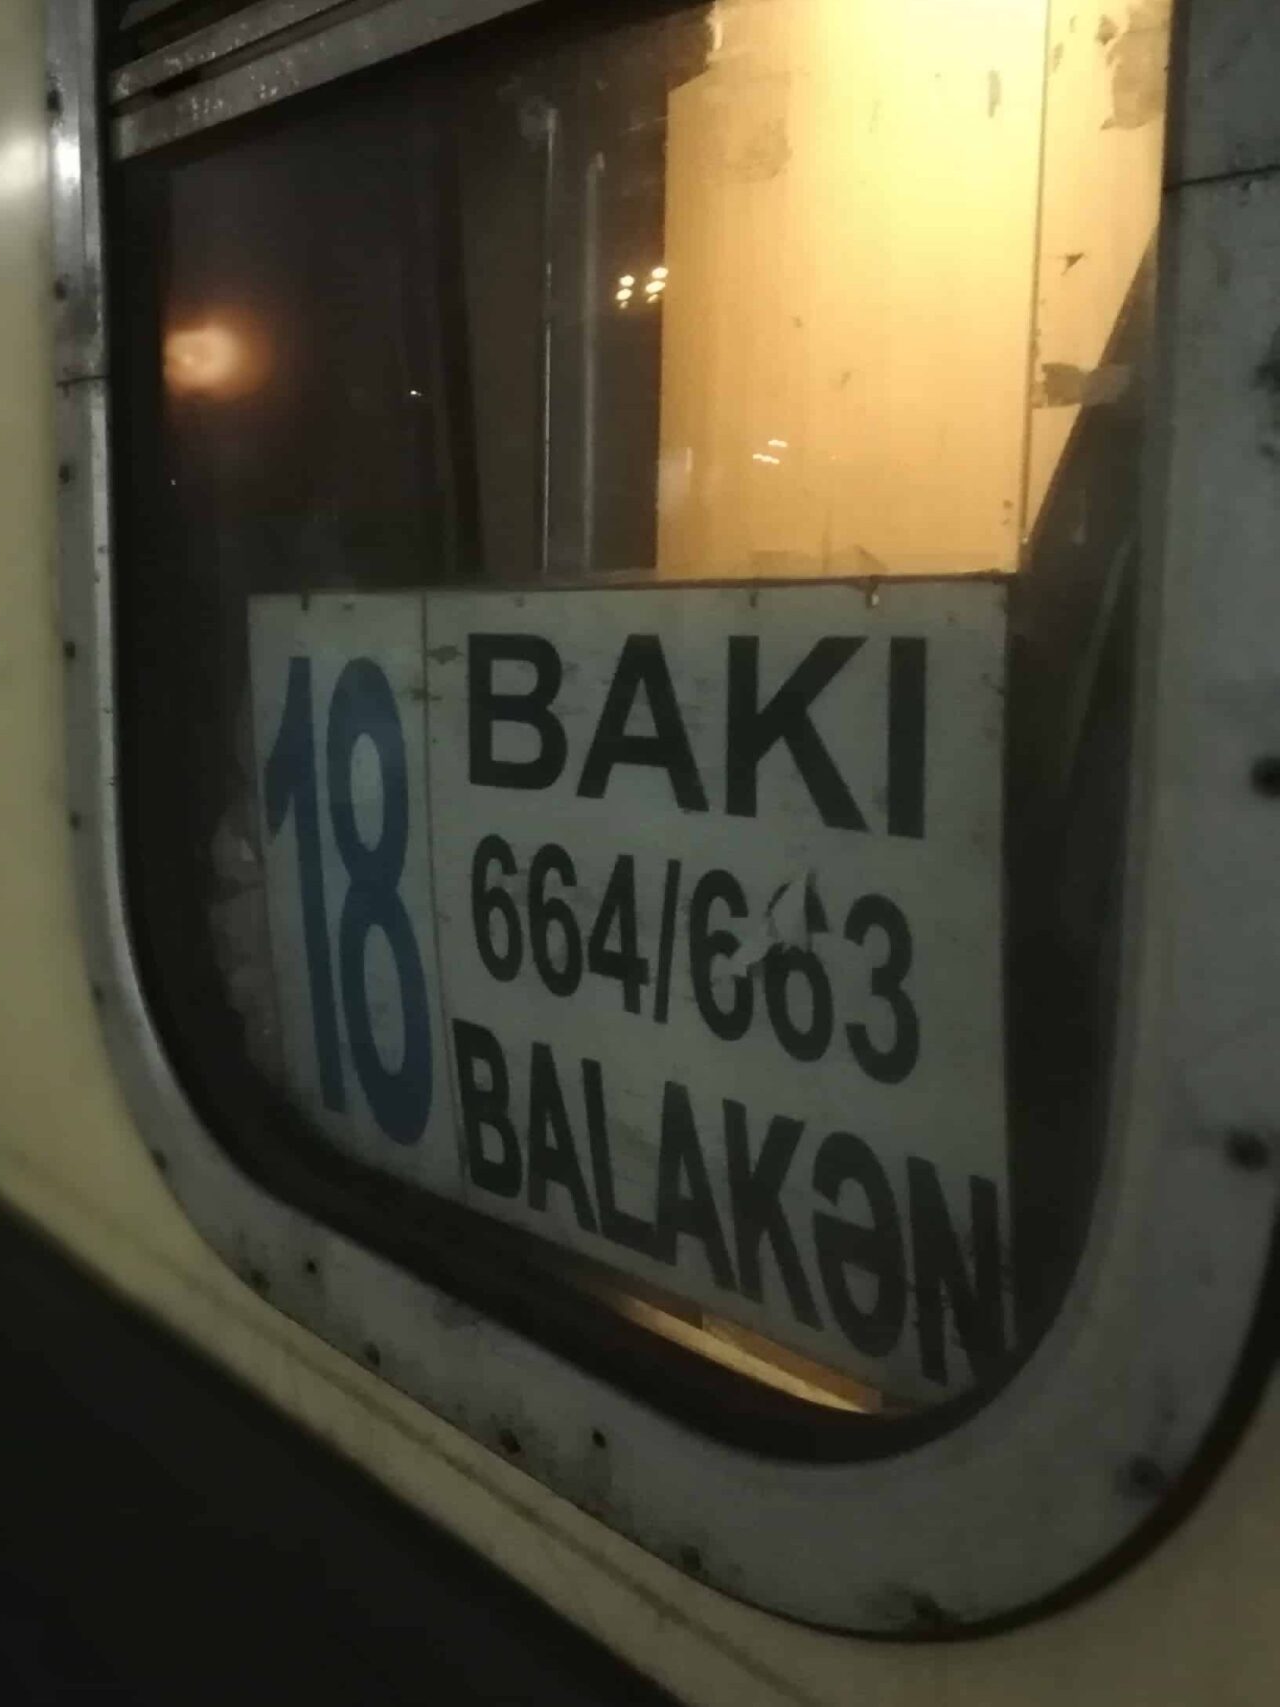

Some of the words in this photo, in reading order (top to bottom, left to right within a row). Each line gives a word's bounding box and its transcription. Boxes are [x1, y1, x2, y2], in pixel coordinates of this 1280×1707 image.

[264, 656, 433, 1147] 18
[467, 632, 928, 840] BAKI
[452, 1017, 1017, 1388] BALAKƏN
